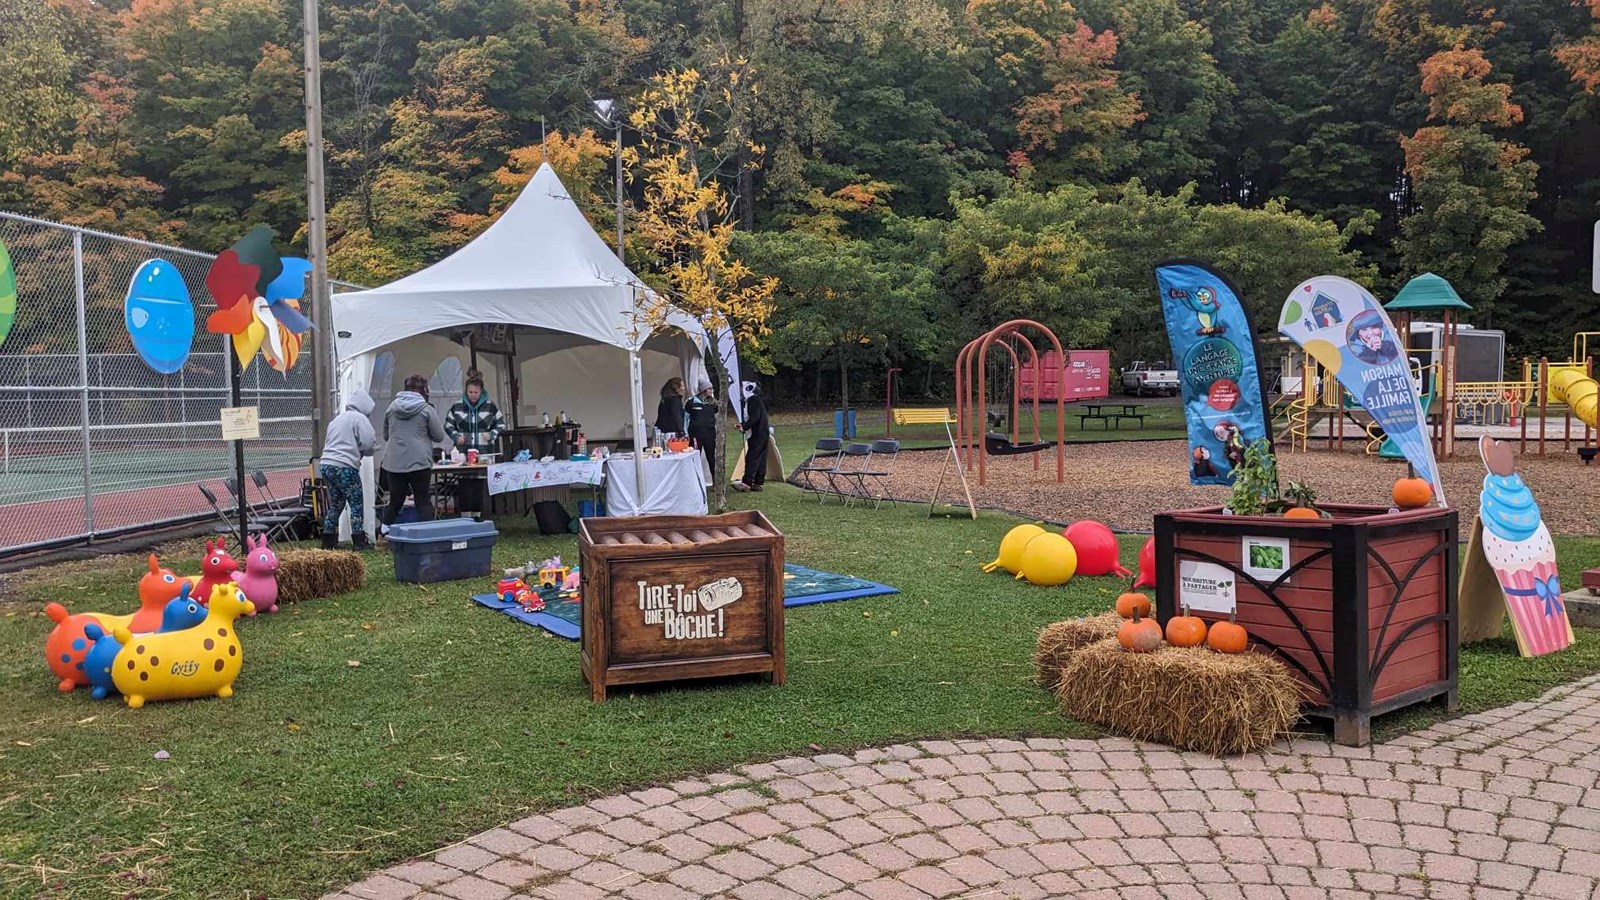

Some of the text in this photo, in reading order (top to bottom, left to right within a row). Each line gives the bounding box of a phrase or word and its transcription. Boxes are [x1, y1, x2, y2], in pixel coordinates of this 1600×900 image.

[1203, 342, 1213, 352] LE
[644, 608, 664, 625] UNE
[170, 659, 200, 677] Gyffy
